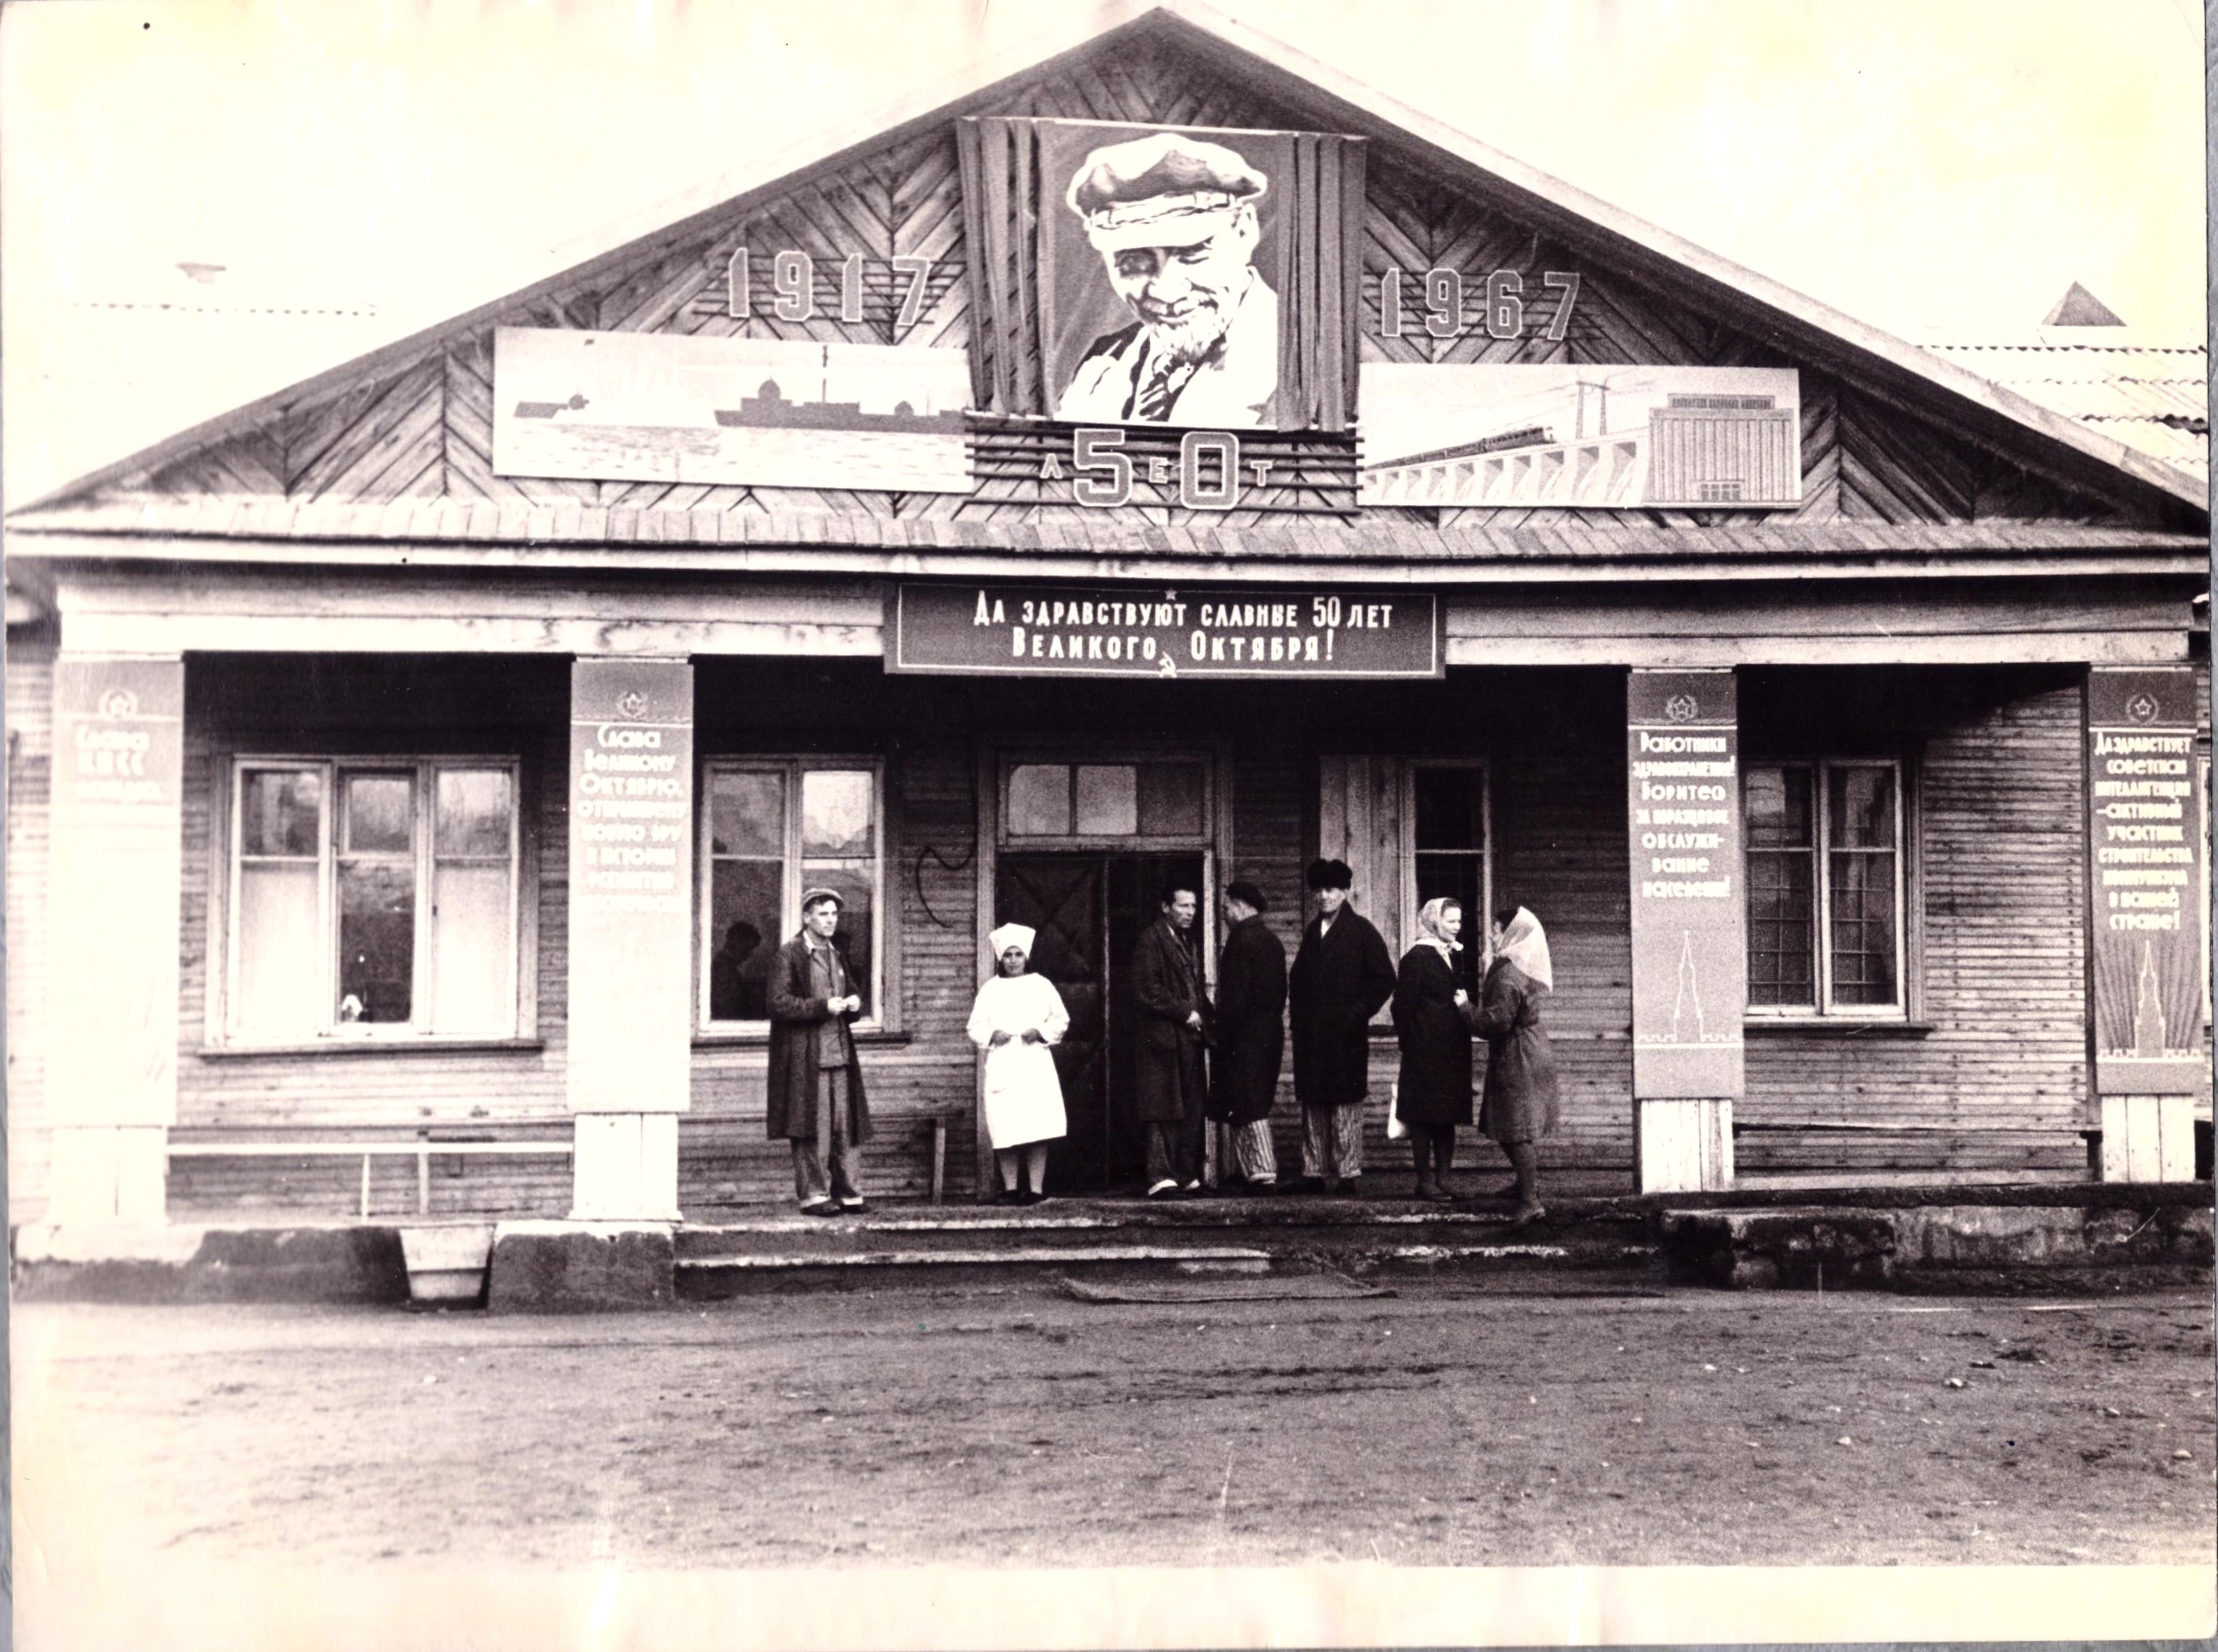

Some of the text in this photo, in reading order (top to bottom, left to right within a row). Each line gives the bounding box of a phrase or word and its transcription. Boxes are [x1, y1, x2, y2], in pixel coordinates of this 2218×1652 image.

[729, 246, 931, 326] 1917
[1381, 267, 1580, 341] 1967
[1073, 428, 1240, 510] 50
[1313, 596, 1341, 627] 50
